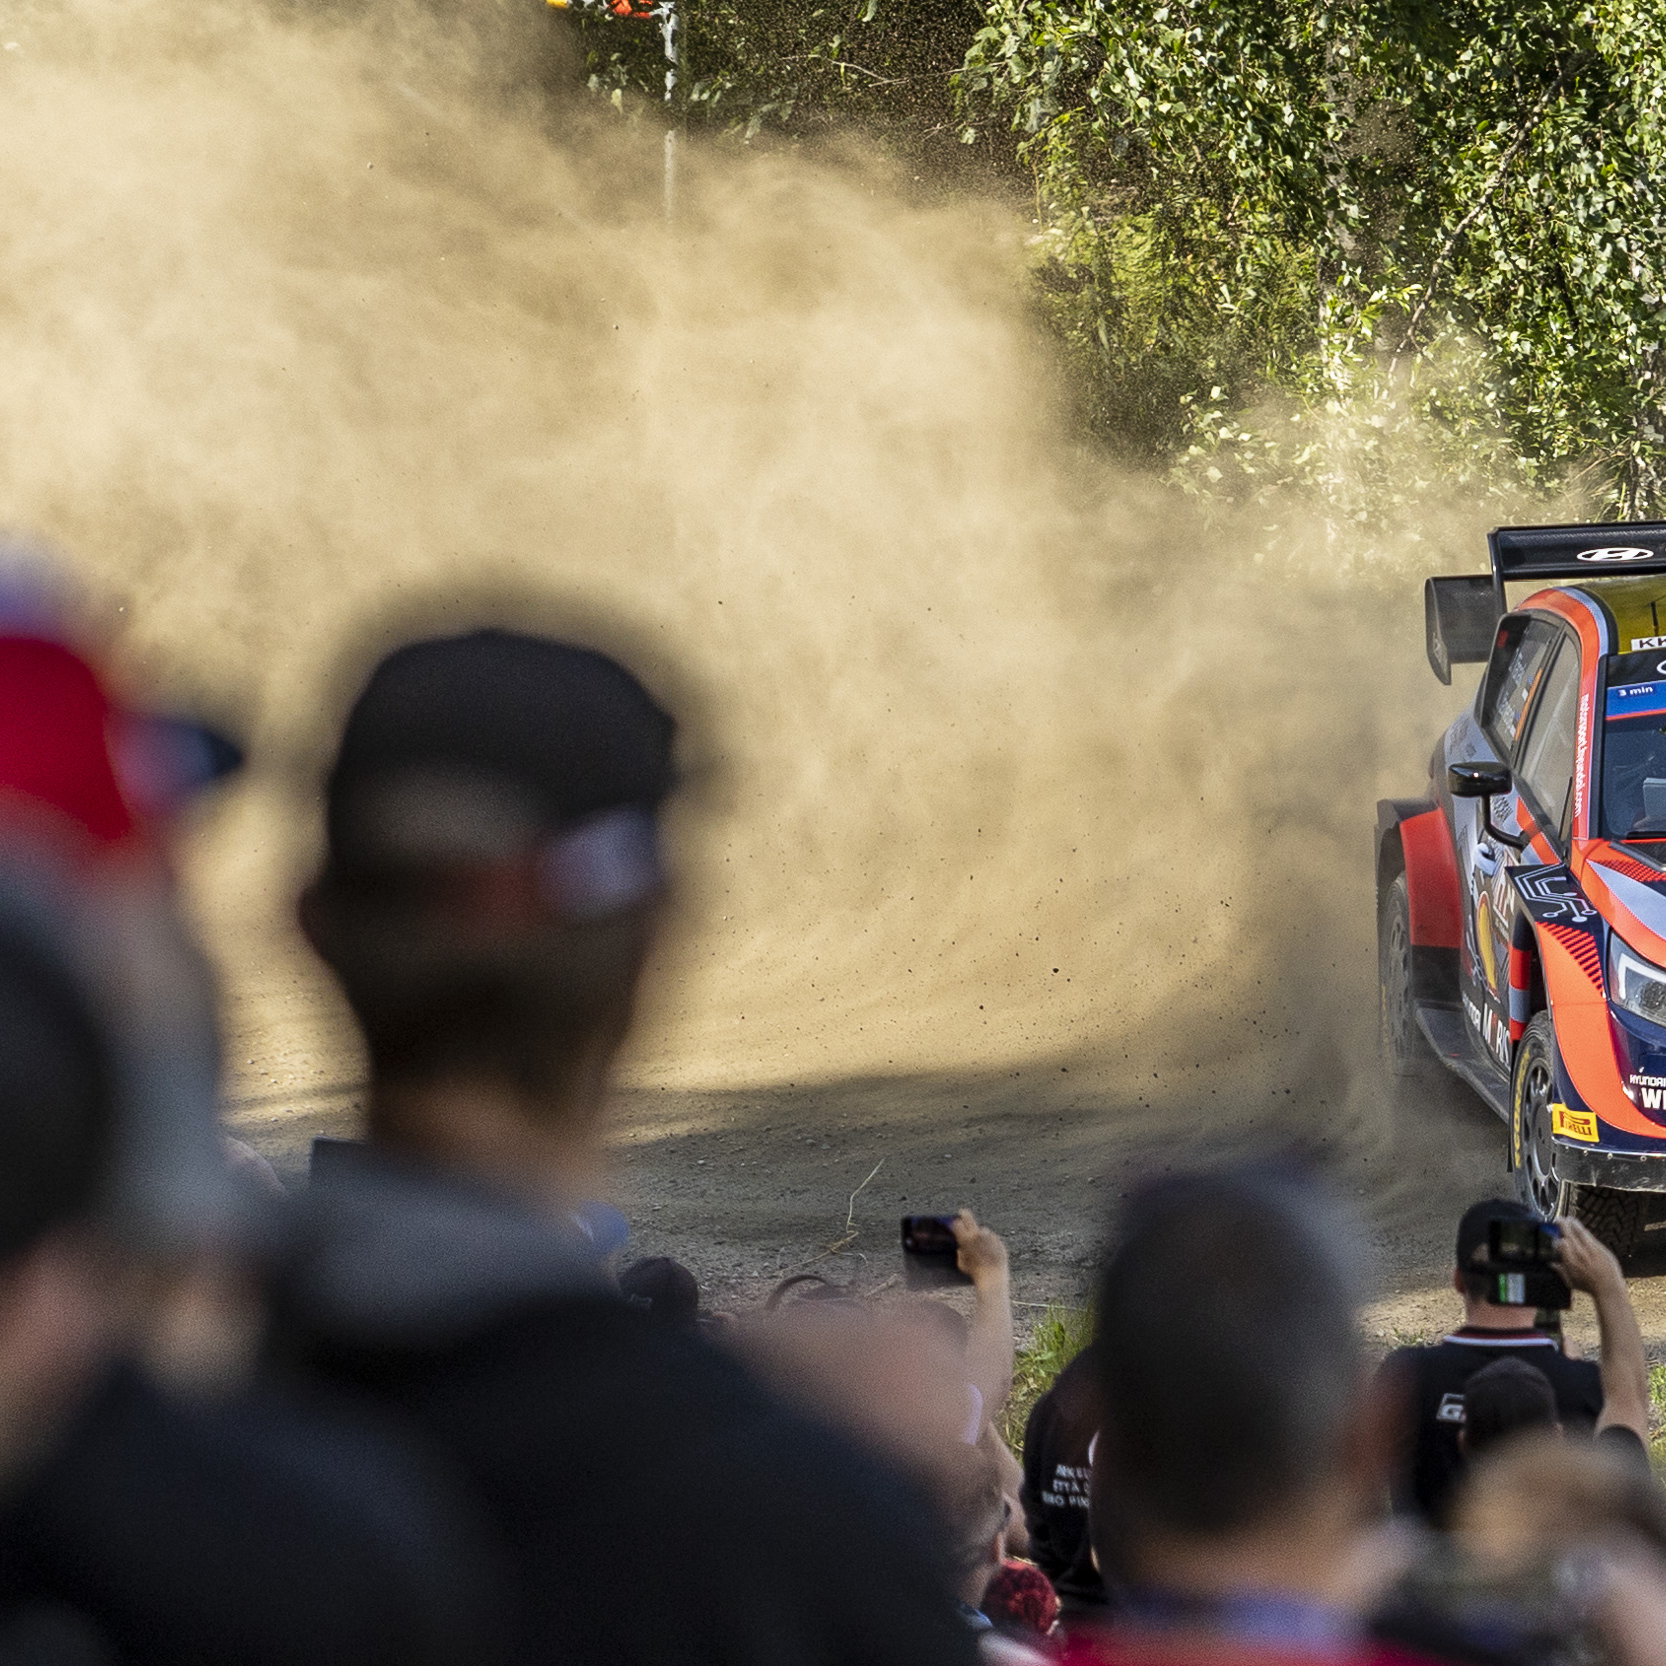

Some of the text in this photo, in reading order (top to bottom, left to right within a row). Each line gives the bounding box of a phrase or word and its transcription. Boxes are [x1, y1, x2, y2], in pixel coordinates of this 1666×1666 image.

[1618, 685, 1654, 697] 3 min
[1629, 1073, 1666, 1088] HYUNDAI
[1559, 1111, 1592, 1136] PIRELLI
